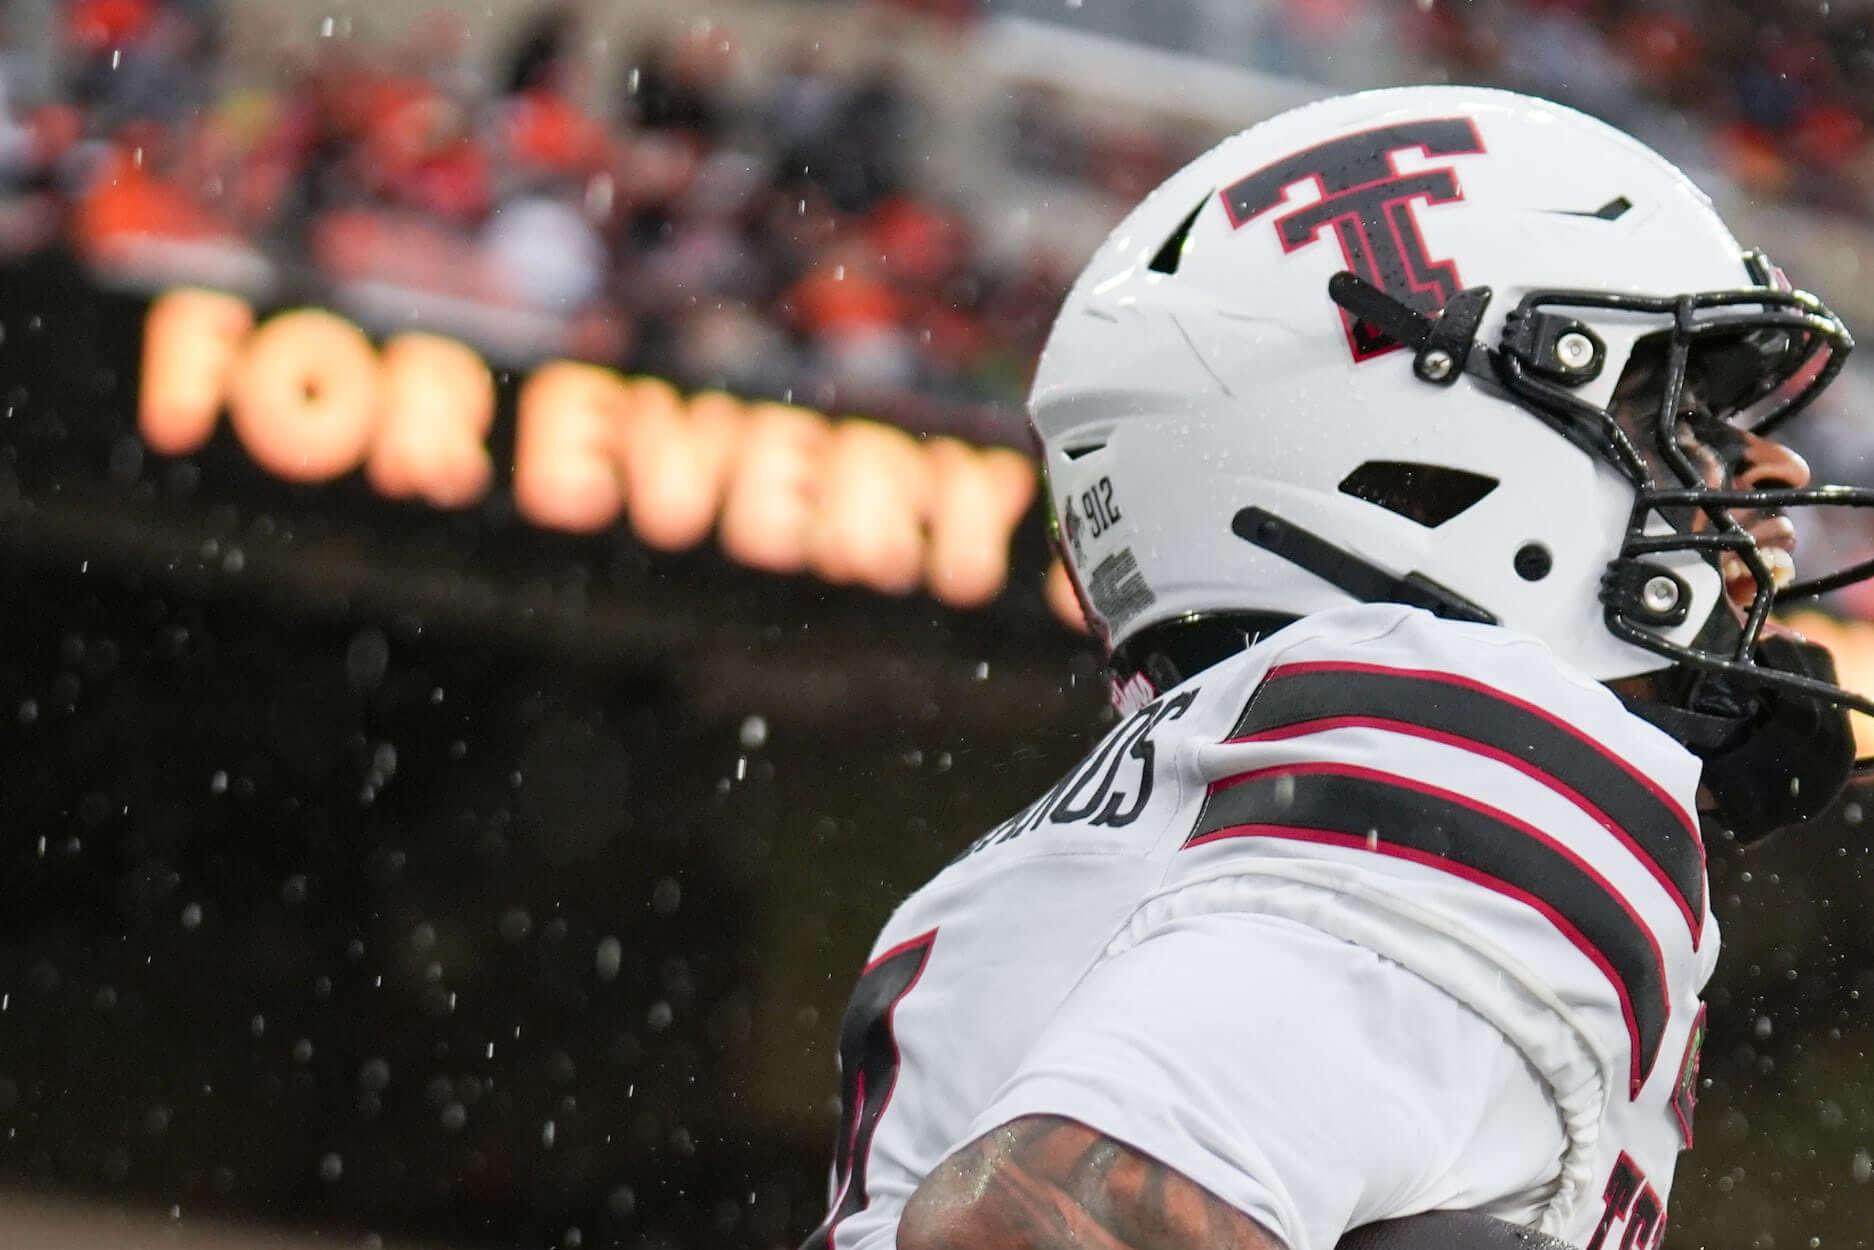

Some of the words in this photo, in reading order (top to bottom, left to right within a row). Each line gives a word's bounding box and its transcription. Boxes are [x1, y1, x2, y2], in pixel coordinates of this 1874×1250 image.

[140, 286, 495, 511] FOR
[513, 360, 1036, 607] EVERY
[1081, 475, 1122, 540] 912
